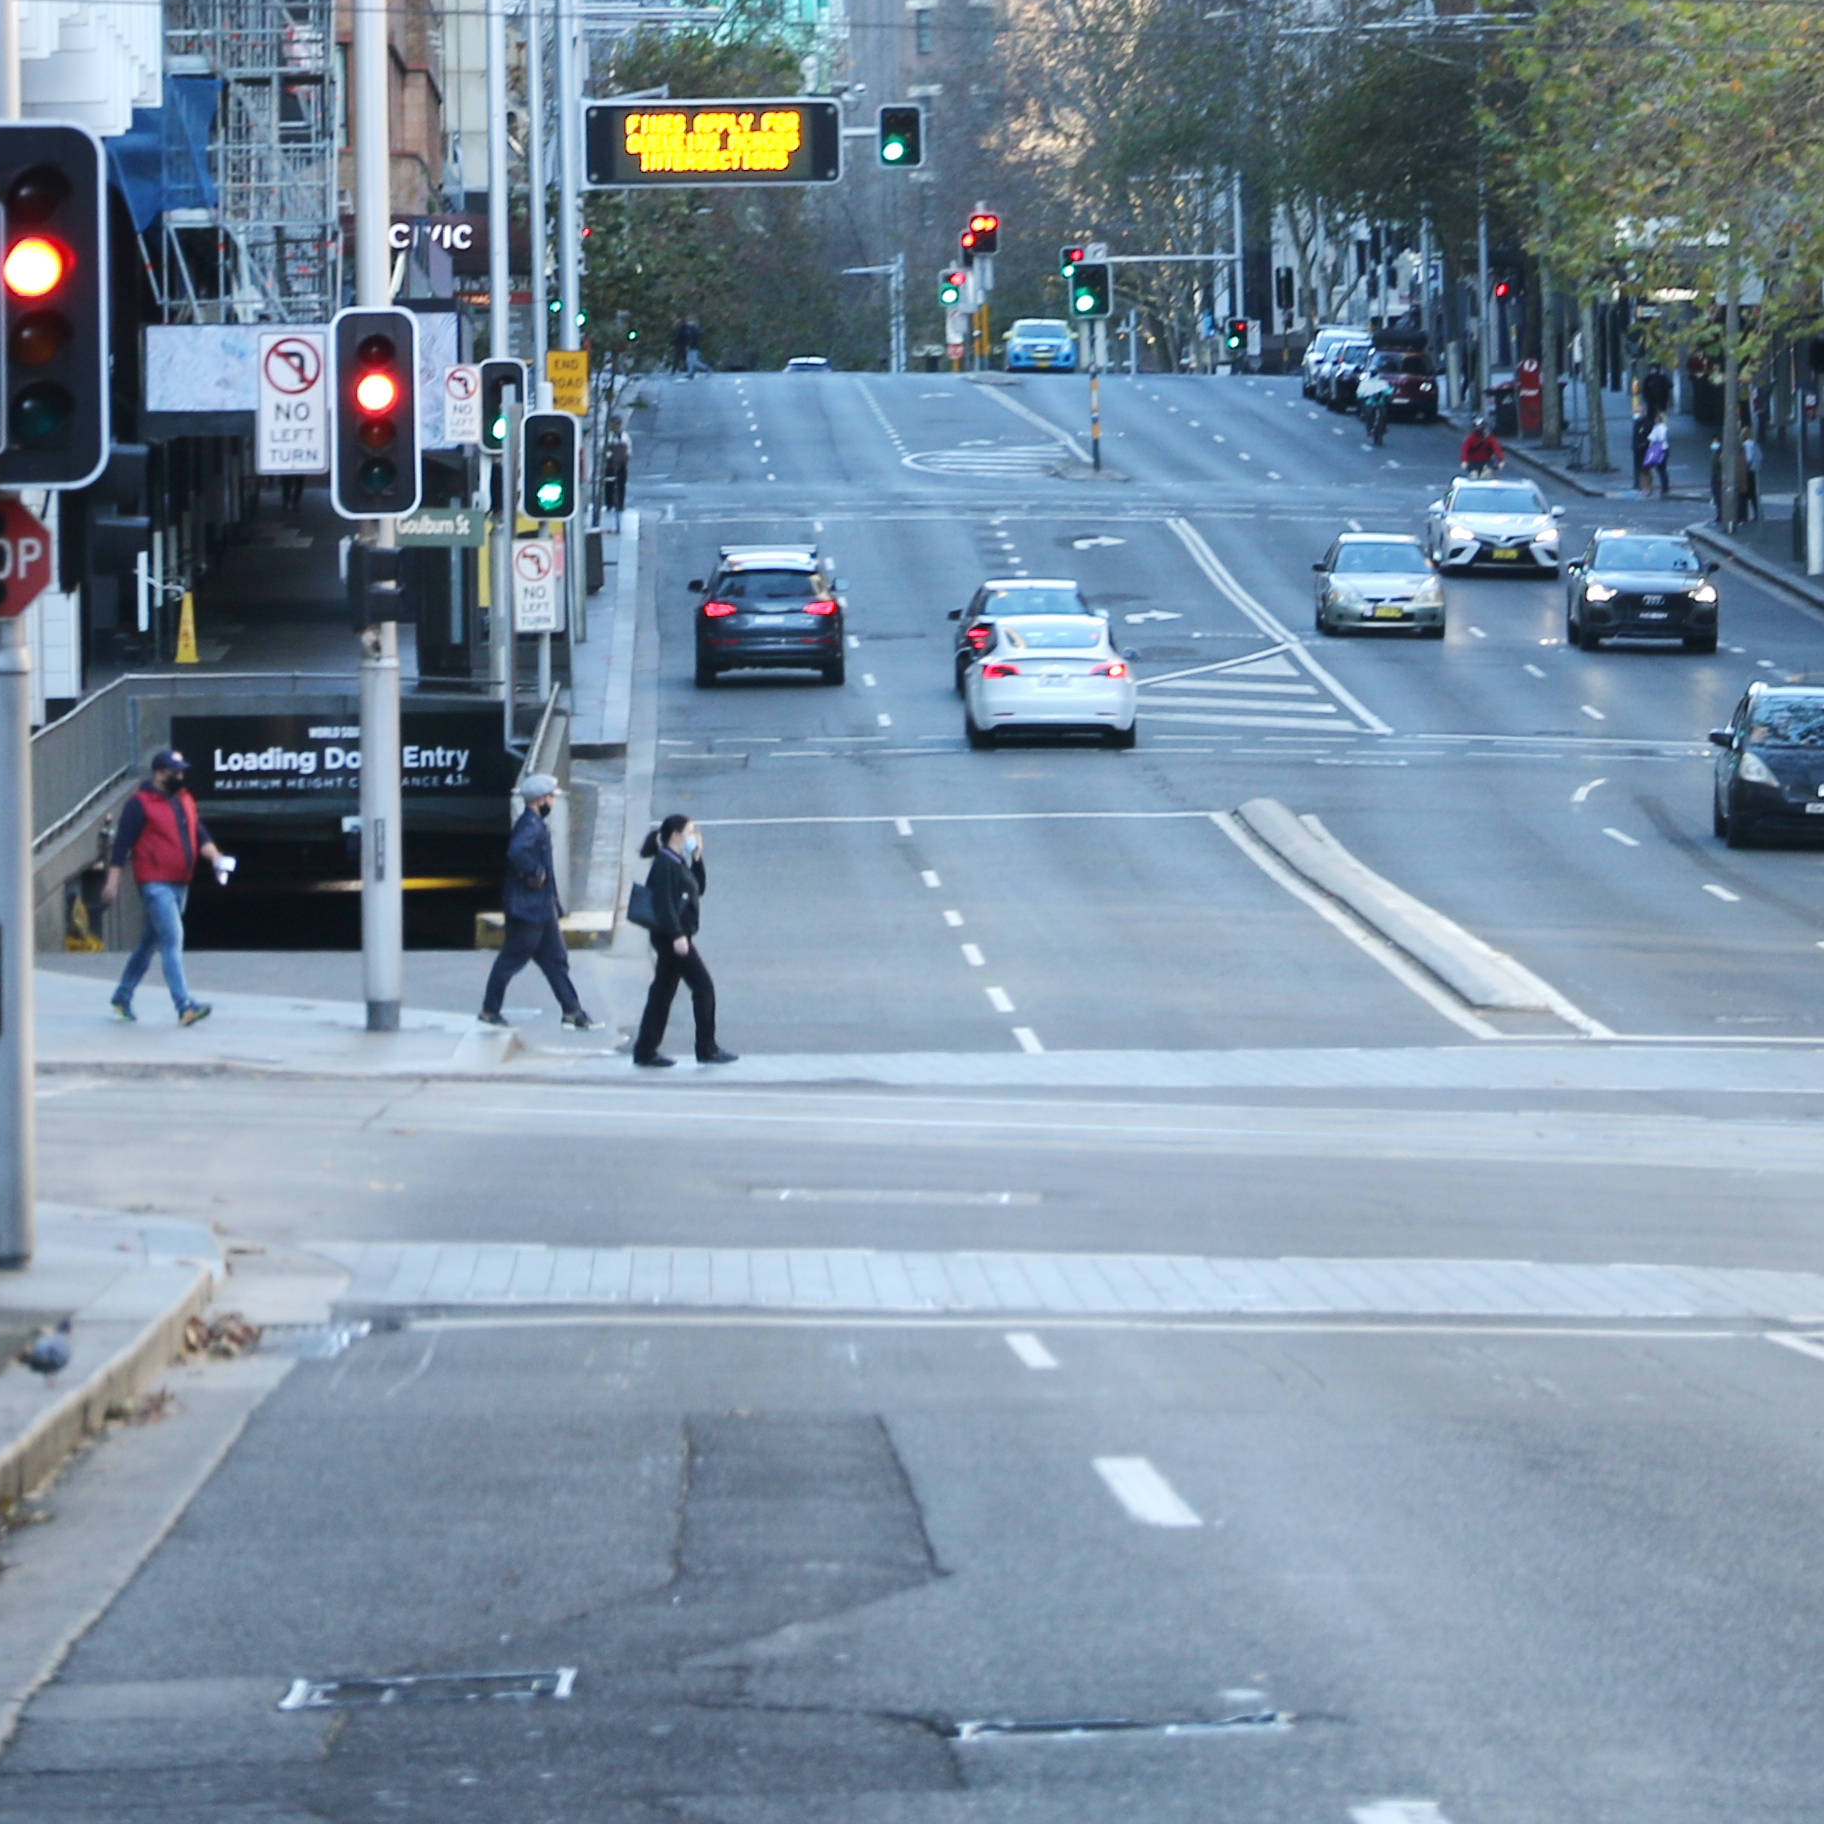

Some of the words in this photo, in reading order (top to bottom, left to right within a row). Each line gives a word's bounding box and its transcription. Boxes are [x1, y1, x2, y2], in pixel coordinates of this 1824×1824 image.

[625, 113, 687, 134] FINES
[692, 112, 756, 133] APPLY
[760, 111, 801, 133] FOR
[726, 131, 801, 153] ACROSS
[639, 150, 790, 172] INTERSECTIONS
[553, 359, 579, 371] END
[275, 403, 310, 422] NO
[453, 403, 473, 416] NO
[450, 416, 474, 427] LEFT
[270, 429, 315, 444] LEFT
[269, 448, 318, 463] TURN
[395, 515, 455, 537] Goulburn
[455, 514, 471, 536] St
[524, 586, 547, 600] NO
[522, 601, 551, 614] LEFT
[520, 613, 552, 626] TURN
[213, 746, 318, 775] Loading
[323, 746, 364, 772] Do
[402, 744, 470, 772] Entry
[213, 778, 283, 791] MAXIMUM
[285, 777, 344, 790] HEIGHT
